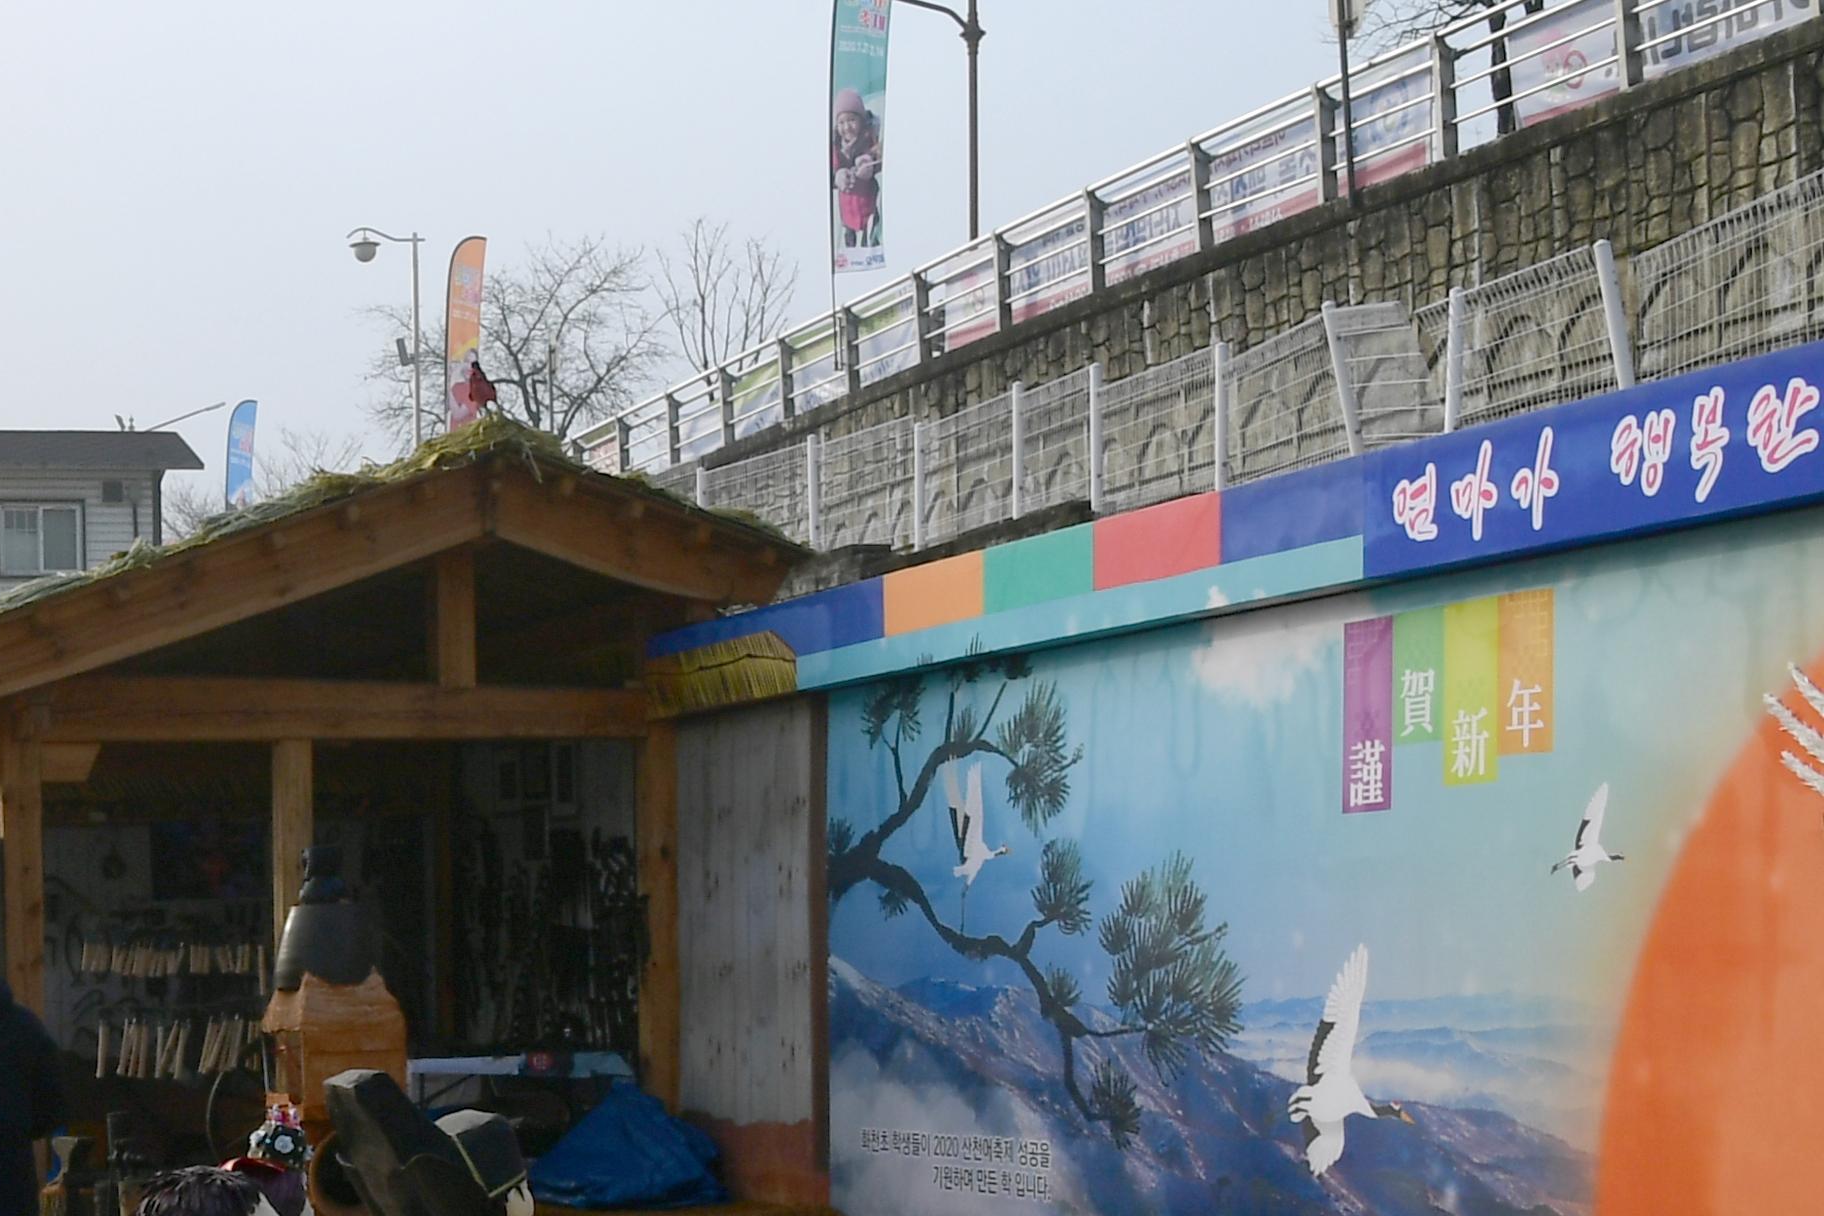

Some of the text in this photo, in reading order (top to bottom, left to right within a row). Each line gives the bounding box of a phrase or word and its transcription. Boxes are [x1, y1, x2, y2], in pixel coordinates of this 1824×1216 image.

[1392, 377, 1820, 541] 엄마가 행복한
[892, 1131, 930, 1158] 학생들이
[933, 1135, 960, 1159] 2020
[961, 1136, 1014, 1164] 산천어축제
[1017, 1140, 1051, 1168] 성공을
[932, 1165, 1051, 1200] 기원하며 만든 학 입니다.
